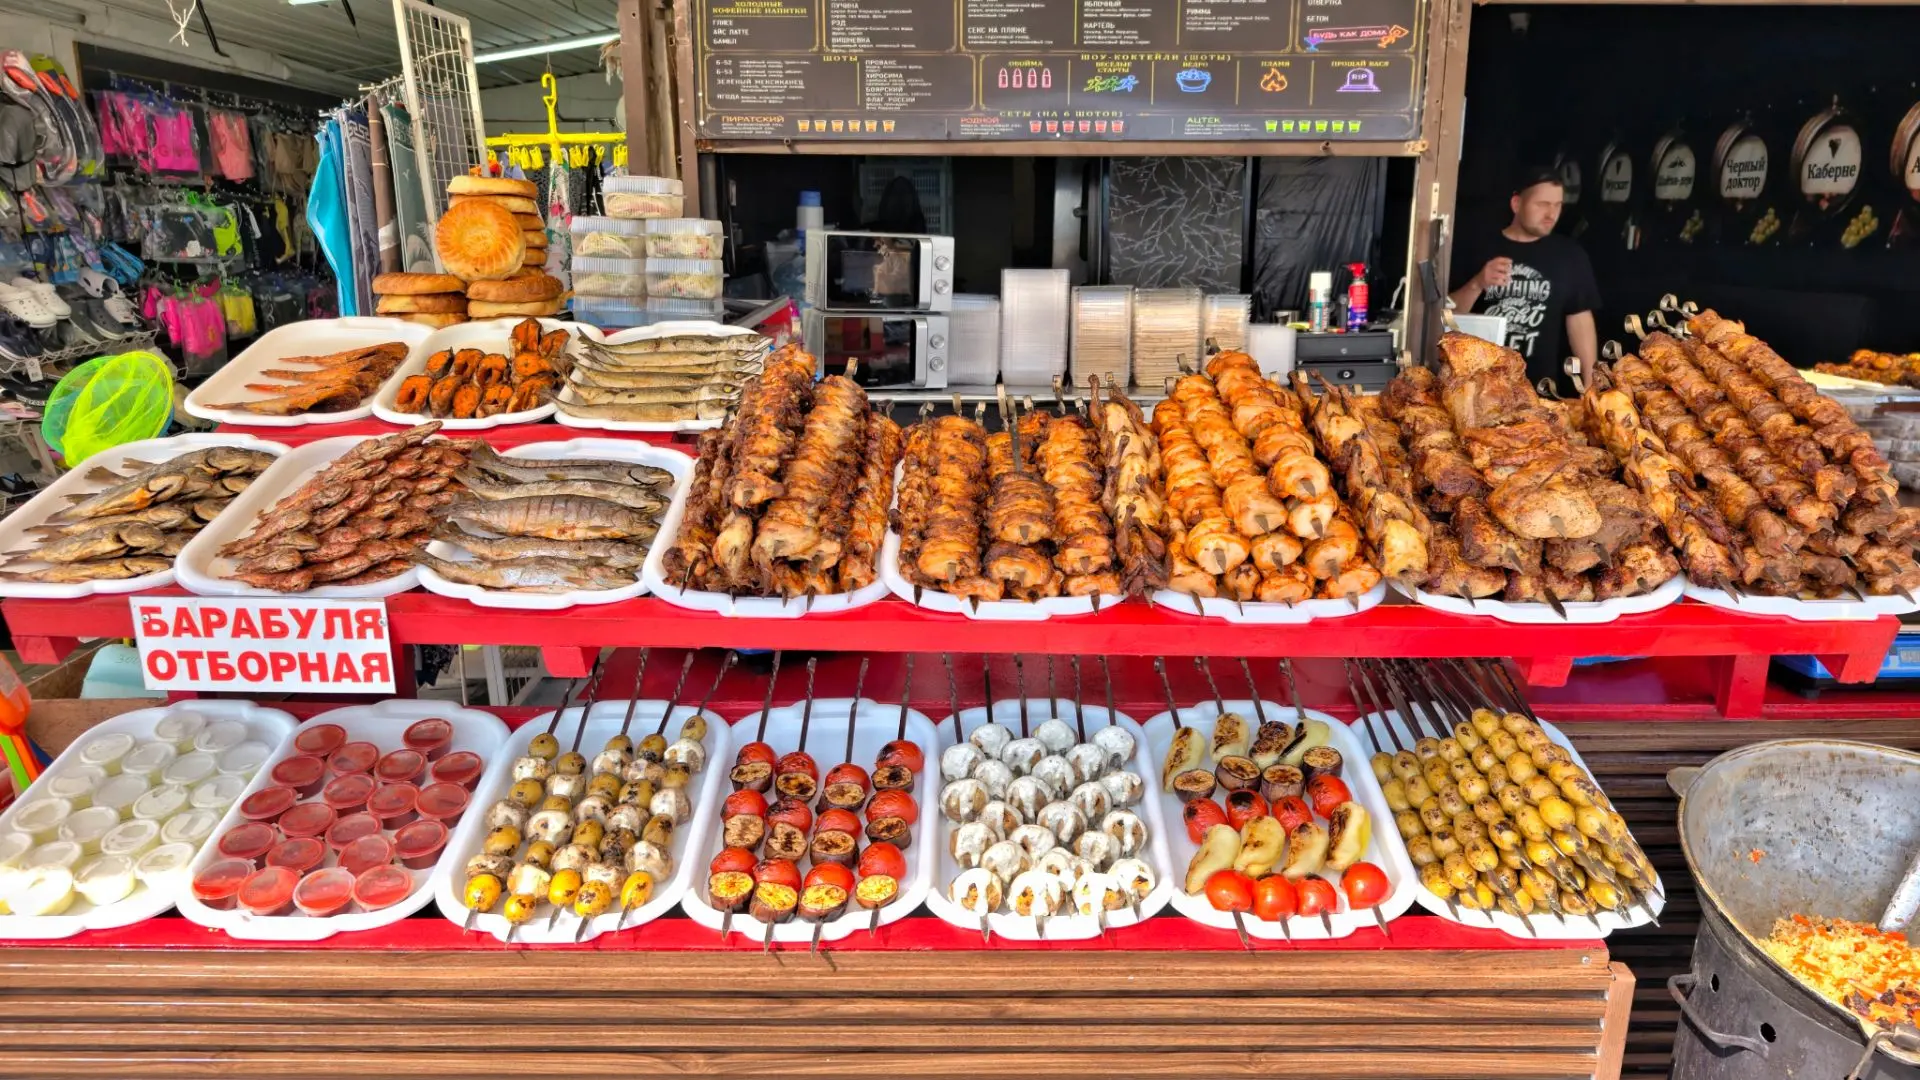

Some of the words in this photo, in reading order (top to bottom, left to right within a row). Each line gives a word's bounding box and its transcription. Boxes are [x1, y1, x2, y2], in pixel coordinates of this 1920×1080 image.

[1726, 156, 1766, 176] Черный
[1808, 163, 1856, 182] Каберне
[1725, 176, 1760, 192] доктор
[139, 606, 385, 640] БАРАБУЛЯ
[146, 650, 390, 683] ОТБОРНАЯ
